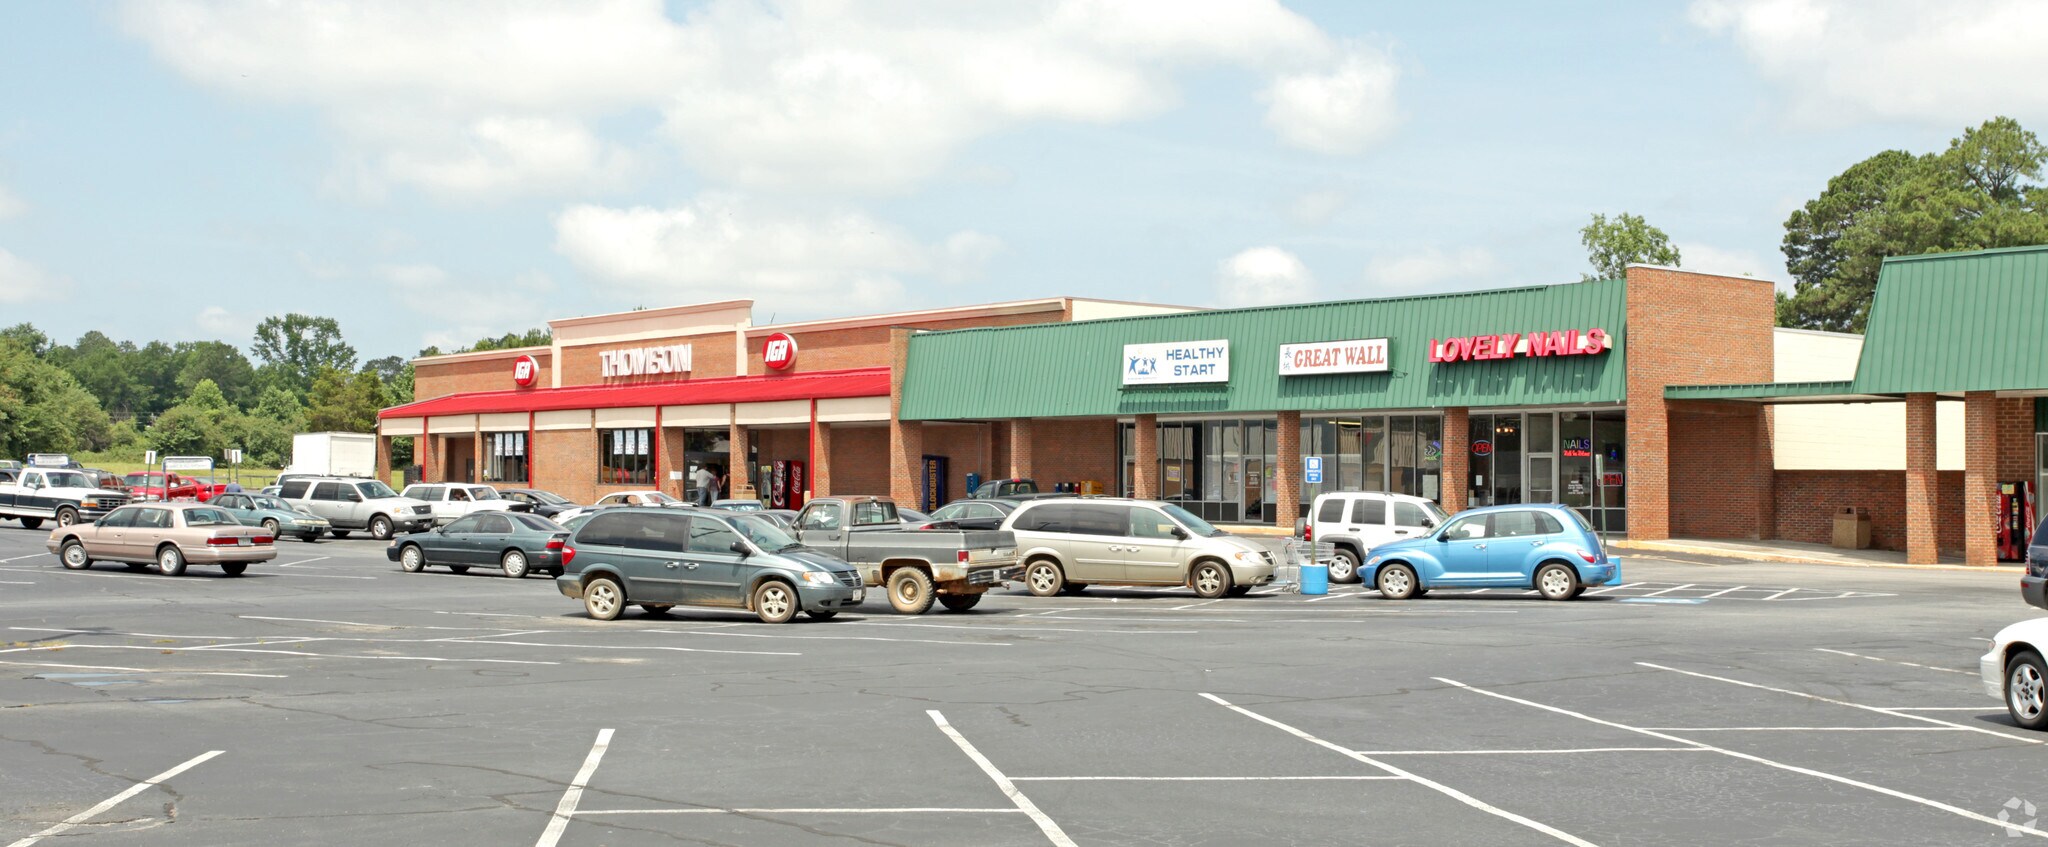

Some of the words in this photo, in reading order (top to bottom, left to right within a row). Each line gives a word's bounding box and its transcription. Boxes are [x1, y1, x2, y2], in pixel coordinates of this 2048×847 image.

[764, 340, 789, 362] IGA
[1166, 347, 1224, 360] HEALTHY
[1428, 333, 1520, 362] LOVELY
[1526, 328, 1606, 357] NAILS
[599, 343, 692, 377] THOMSON
[1294, 348, 1341, 368] GREAT
[1345, 345, 1384, 365] WALL
[514, 360, 532, 379] IGA
[1174, 363, 1215, 376] START
[1471, 443, 1492, 453] OPEN
[1563, 439, 1590, 449] NAILS
